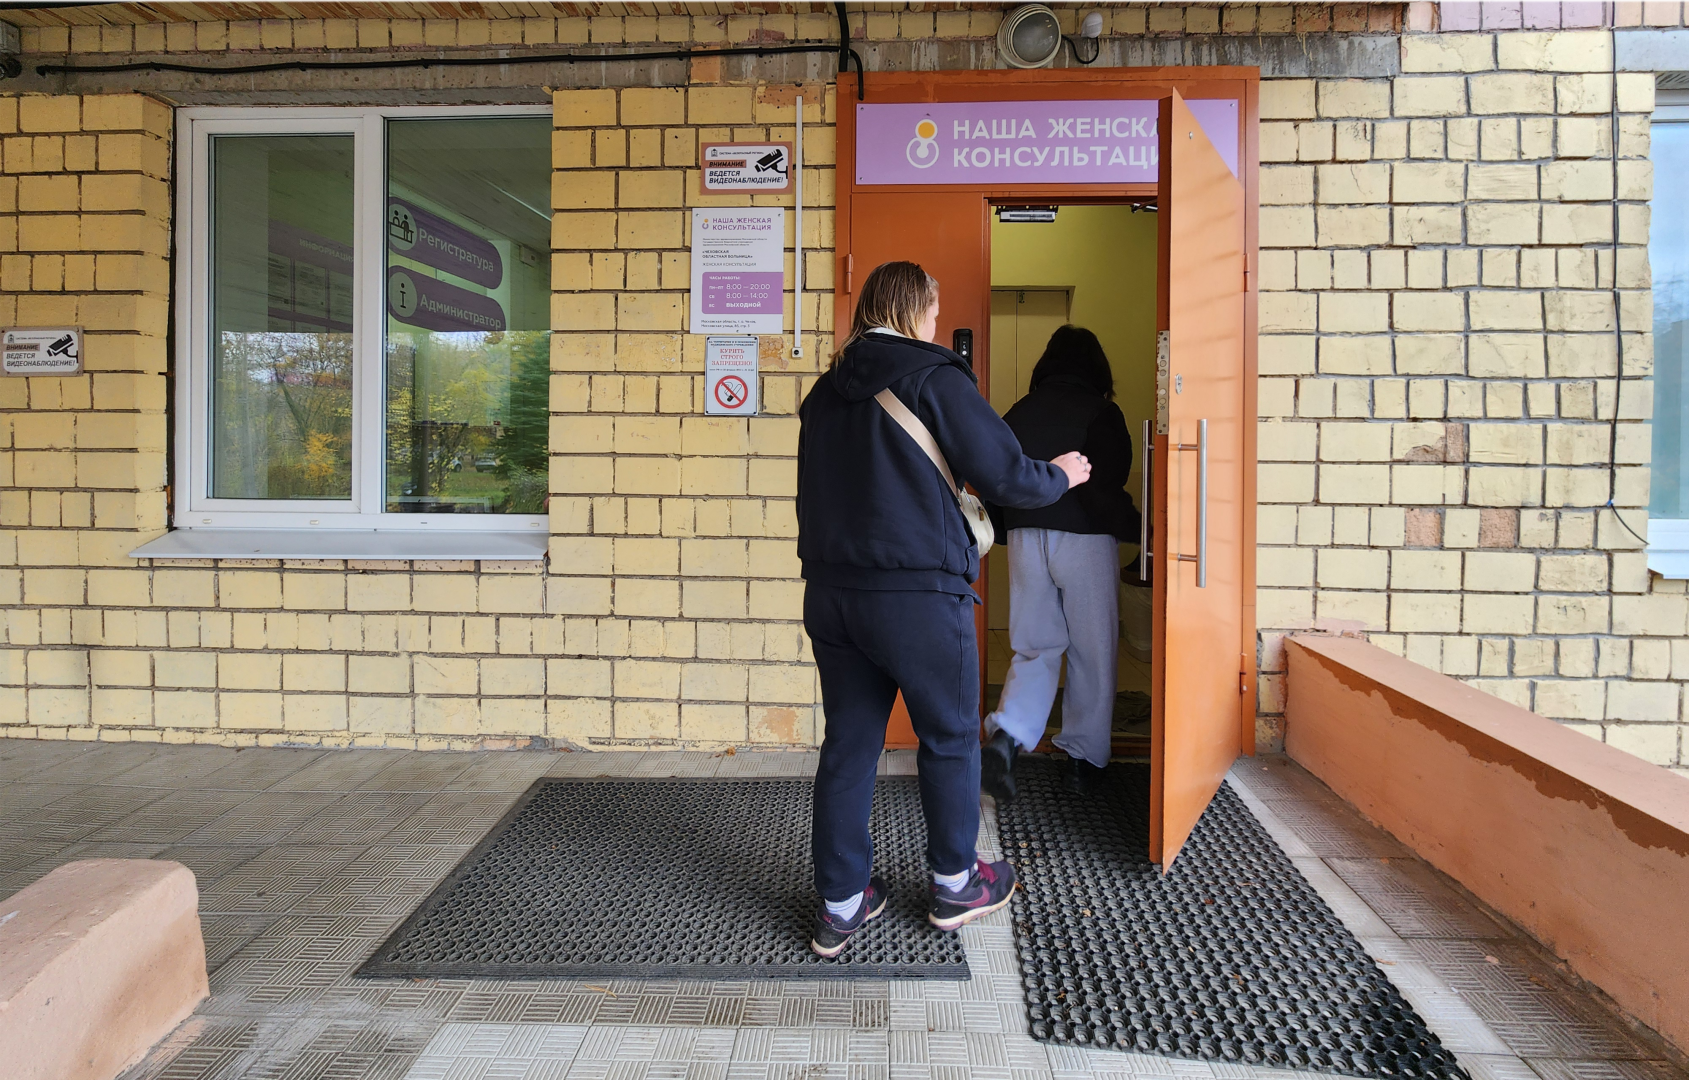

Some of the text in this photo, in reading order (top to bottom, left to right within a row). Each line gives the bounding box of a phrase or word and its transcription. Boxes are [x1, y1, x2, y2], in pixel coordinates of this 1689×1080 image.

[953, 119, 1037, 140] НАША
[418, 228, 494, 272] Регистратура
[420, 294, 501, 330] Администратор
